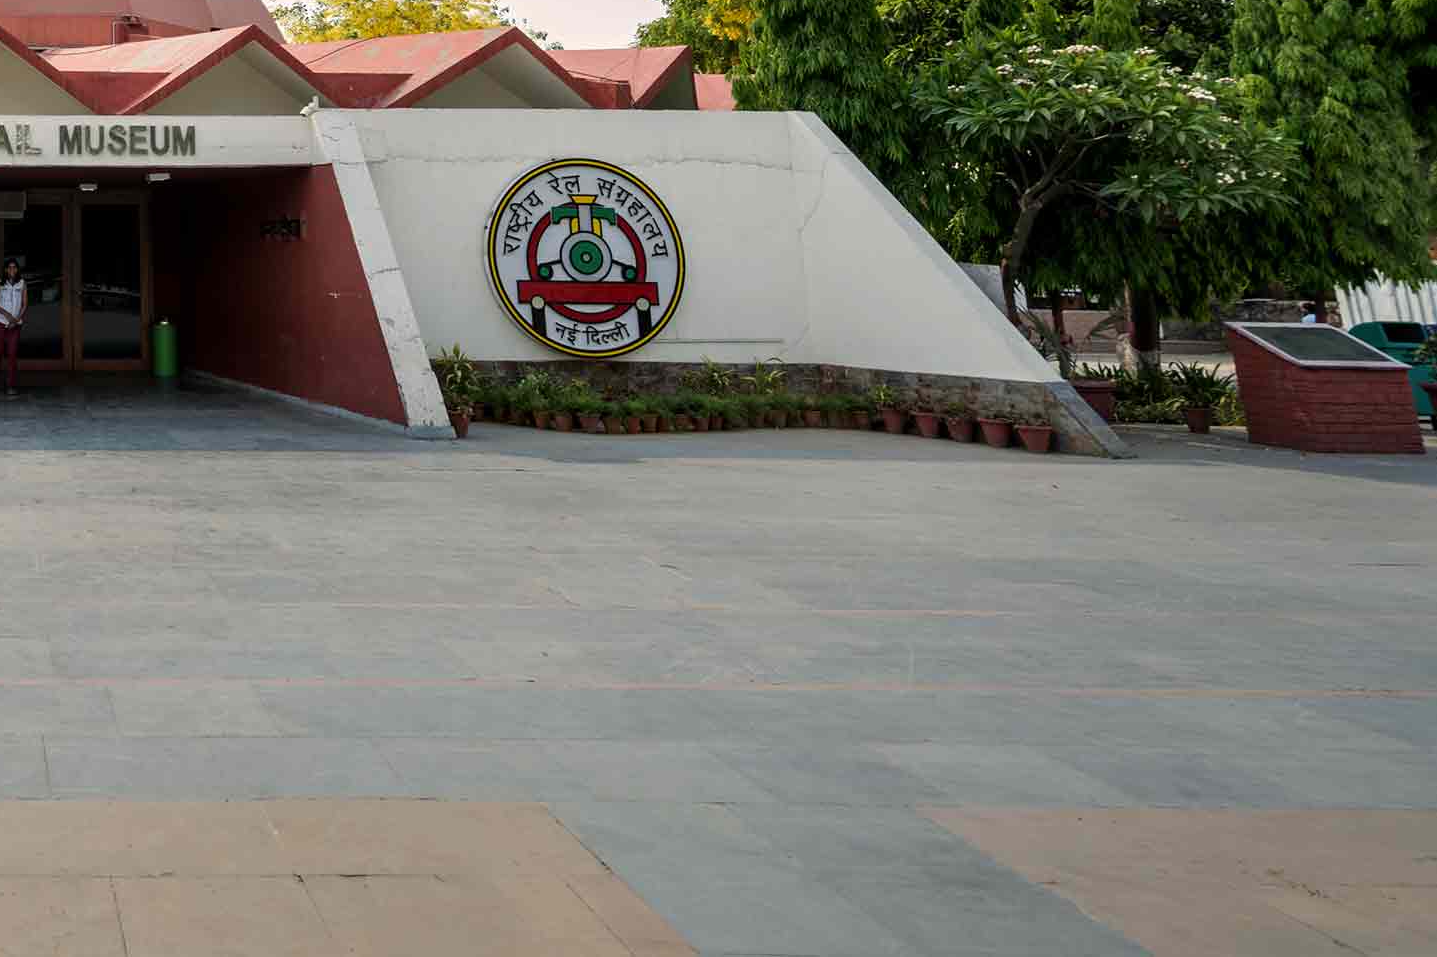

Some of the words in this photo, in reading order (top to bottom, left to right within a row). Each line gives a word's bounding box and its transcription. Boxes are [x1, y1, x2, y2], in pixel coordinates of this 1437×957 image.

[58, 124, 197, 156] MUSEUM
[503, 190, 544, 256] राष्ट्रीय
[547, 171, 581, 195] रेल
[596, 177, 668, 259] संग्रहालय
[555, 322, 582, 345] नई
[583, 321, 630, 346] दिल्ली
